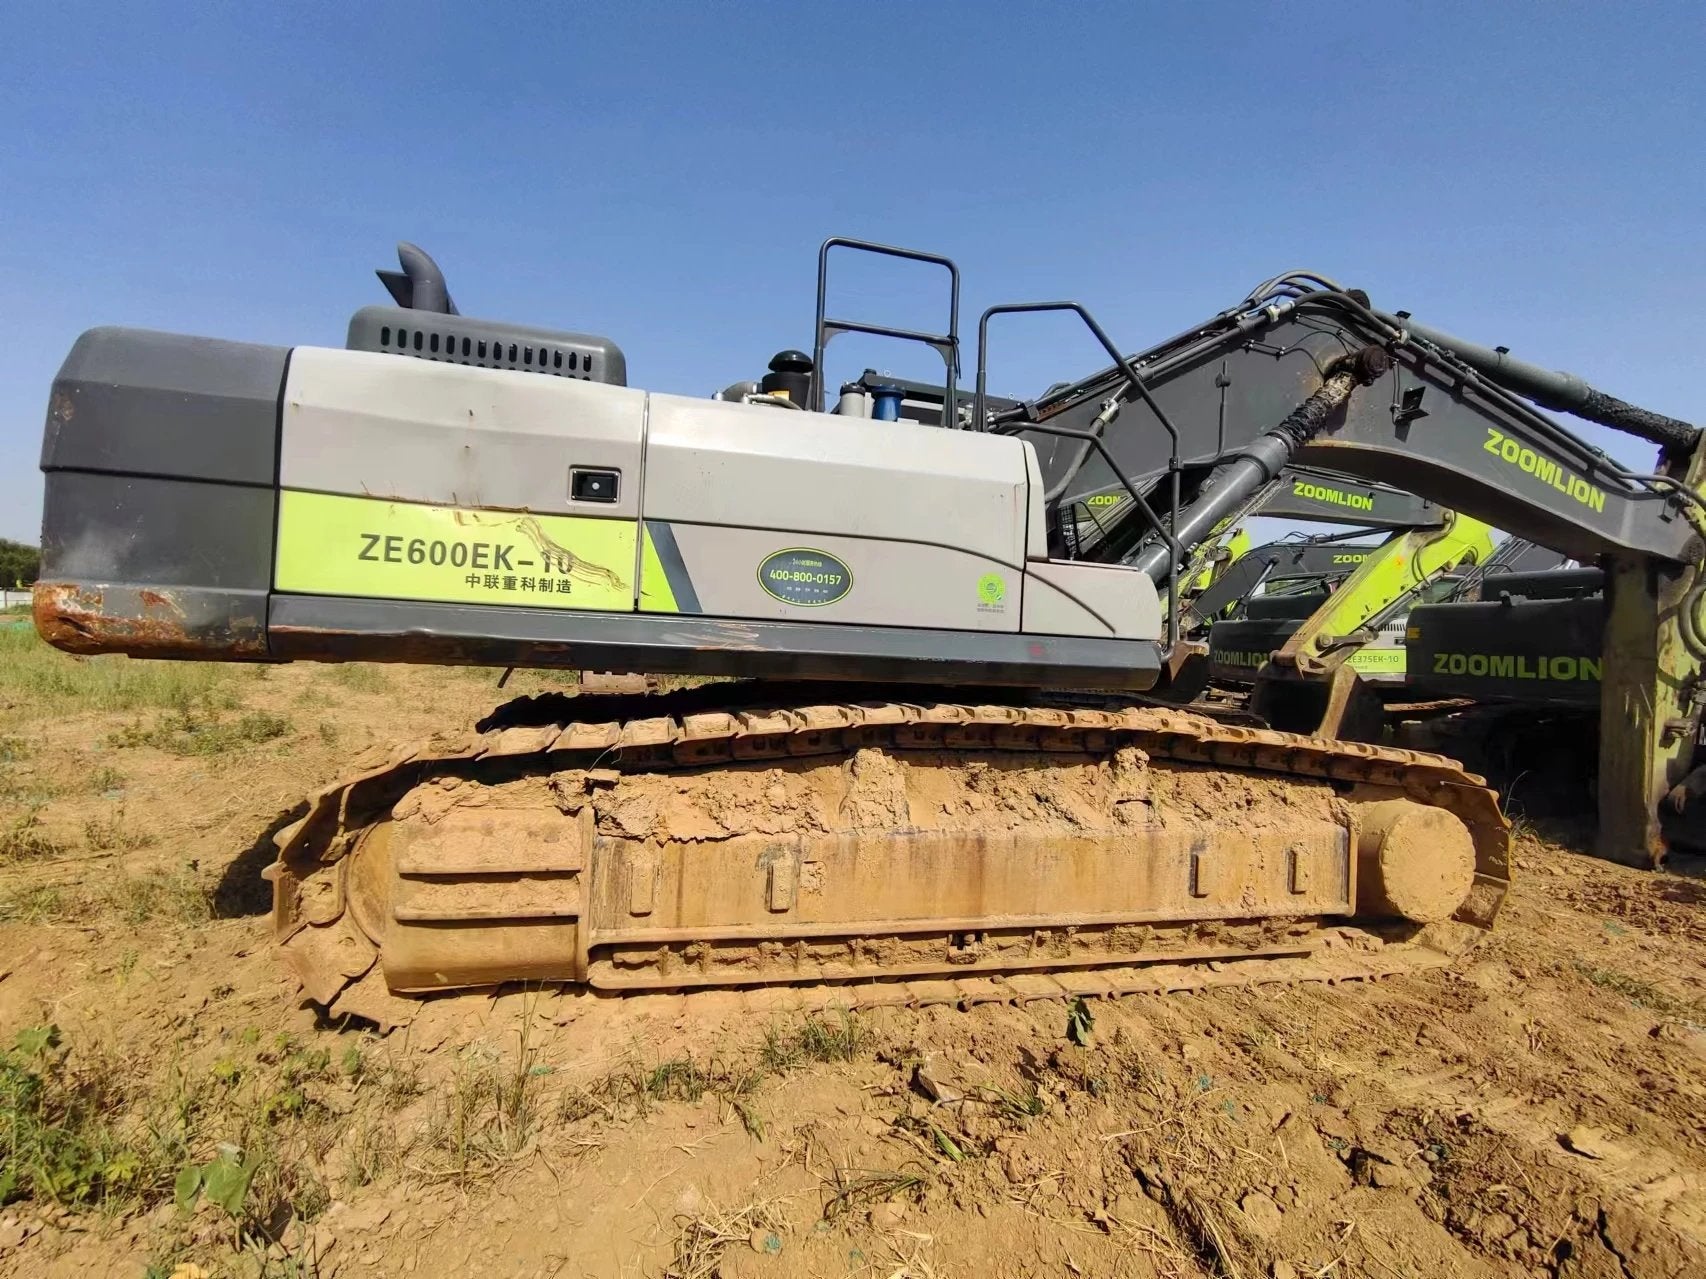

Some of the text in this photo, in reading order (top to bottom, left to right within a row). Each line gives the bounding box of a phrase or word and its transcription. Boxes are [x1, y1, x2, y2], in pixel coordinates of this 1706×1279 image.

[1483, 428, 1606, 514] ZOOMLION
[1293, 482, 1374, 511] ZOOMLION
[358, 533, 573, 575] ZE600EK-10
[465, 573, 572, 594] 中联重科制造
[769, 569, 841, 585] 400-800-0157
[1433, 653, 1606, 681] ZOOMLION
